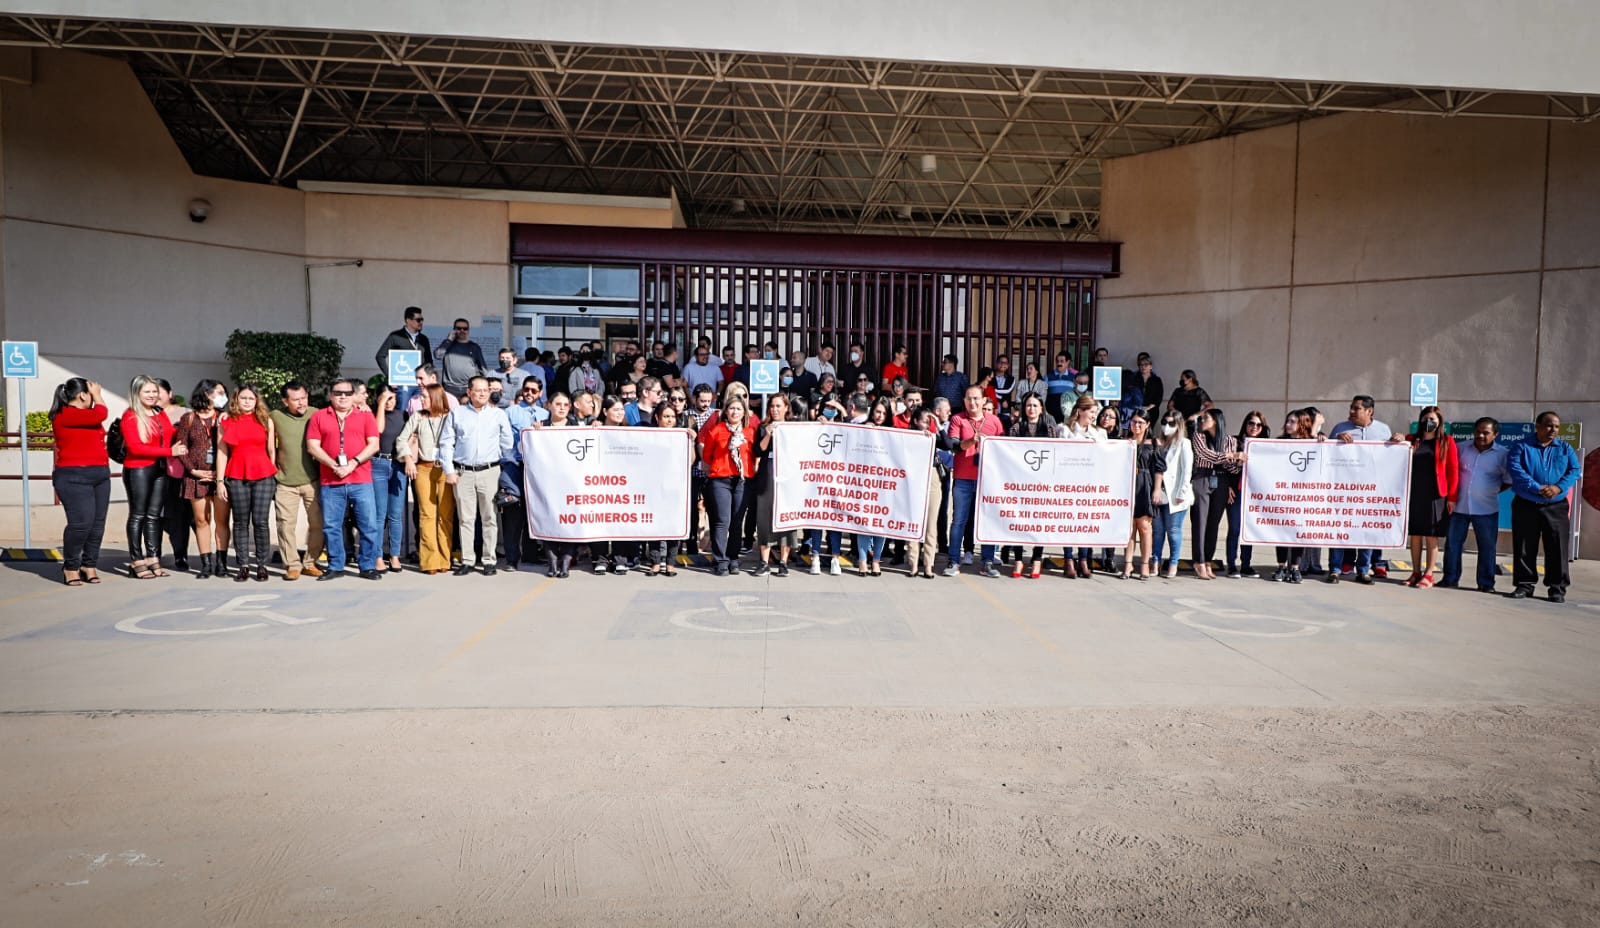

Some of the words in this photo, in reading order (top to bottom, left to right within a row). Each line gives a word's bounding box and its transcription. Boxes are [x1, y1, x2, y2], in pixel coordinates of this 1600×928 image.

[799, 461, 845, 472] TENEMOS
[848, 464, 906, 478] DERECHOS
[584, 475, 627, 486] SOMOS
[803, 473, 833, 484] COMO
[837, 476, 897, 490] CUALQUIER
[1275, 481, 1289, 489] SR.
[1292, 482, 1331, 490] MINISTRO
[1004, 482, 1051, 492] SOLUCIÓN:
[1054, 484, 1096, 493] CREACIÓN
[817, 486, 878, 501] TABAJADOR
[1265, 494, 1324, 502] AUTORIZAMOS
[1327, 495, 1344, 503] QUE
[1366, 496, 1400, 504] SEPARE
[566, 494, 630, 505] PERSONAS
[983, 496, 1018, 504] NUEVOS
[1020, 498, 1073, 506] TRIBUNALES
[1076, 499, 1128, 507] COLEGIADOS
[804, 499, 820, 508] NO
[823, 500, 860, 512] HEMOS
[863, 504, 889, 515] SIDO
[1249, 505, 1259, 513] DE
[1262, 506, 1300, 514] NUESTRO
[1342, 508, 1353, 516] DE
[1356, 509, 1401, 517] NUESTRAS
[559, 514, 576, 524] NO
[580, 511, 637, 524] NÚMEROS
[1000, 510, 1016, 518] DEL
[1033, 511, 1075, 520] CIRCUITO,
[1091, 512, 1110, 520] ESTA
[780, 511, 843, 522] ESCUCHADOS
[847, 515, 868, 526] POR
[872, 519, 884, 528] EL
[887, 520, 906, 531] CJF
[1256, 518, 1303, 527] FAMILIAS...
[1305, 519, 1341, 528] TRABAJO
[1362, 521, 1392, 529] ACOSO
[1009, 524, 1042, 532] CIUDAD
[1058, 524, 1100, 533] CULIACÁN
[1296, 532, 1334, 540] LABORAL
